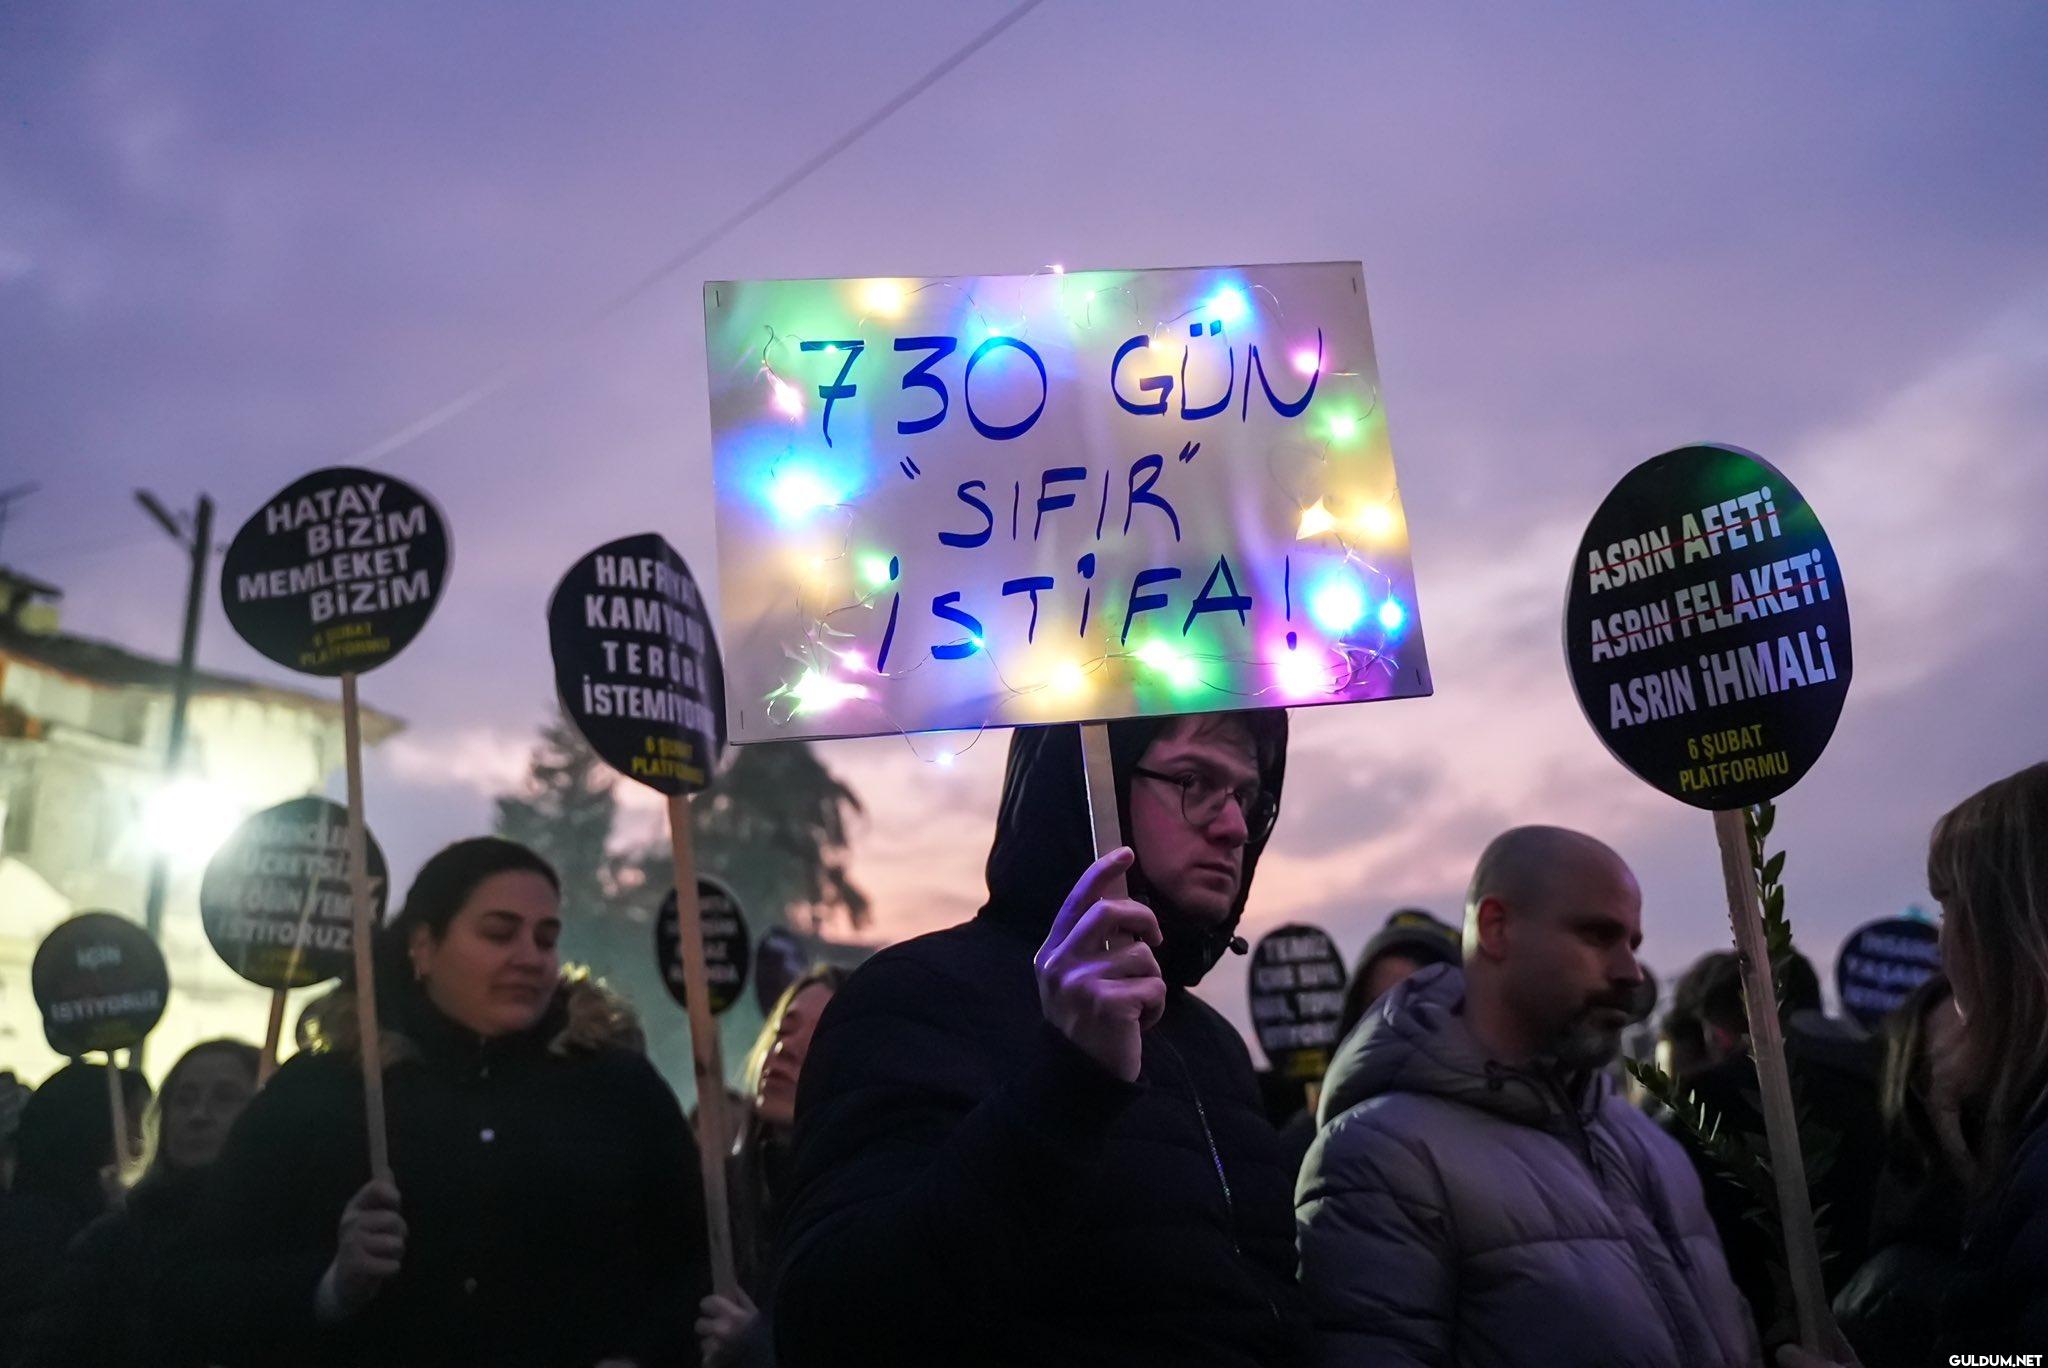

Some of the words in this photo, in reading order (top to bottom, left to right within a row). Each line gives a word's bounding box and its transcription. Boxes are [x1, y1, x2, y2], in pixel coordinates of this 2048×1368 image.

[799, 336, 1047, 447] 730
[1111, 320, 1324, 423] GÜN
[265, 483, 387, 535] HATAY
[306, 505, 427, 556] BİZİM
[237, 544, 412, 603] MEMLEKET
[1588, 526, 1676, 594] ASRIN
[309, 569, 431, 624] BİZİM
[1591, 599, 1674, 663] ASRIN
[1609, 665, 1697, 729] ASRIN
[1687, 737, 1699, 760] 6
[1702, 724, 1763, 761] ŞUBAT
[1679, 752, 1789, 792] PLATFORMU
